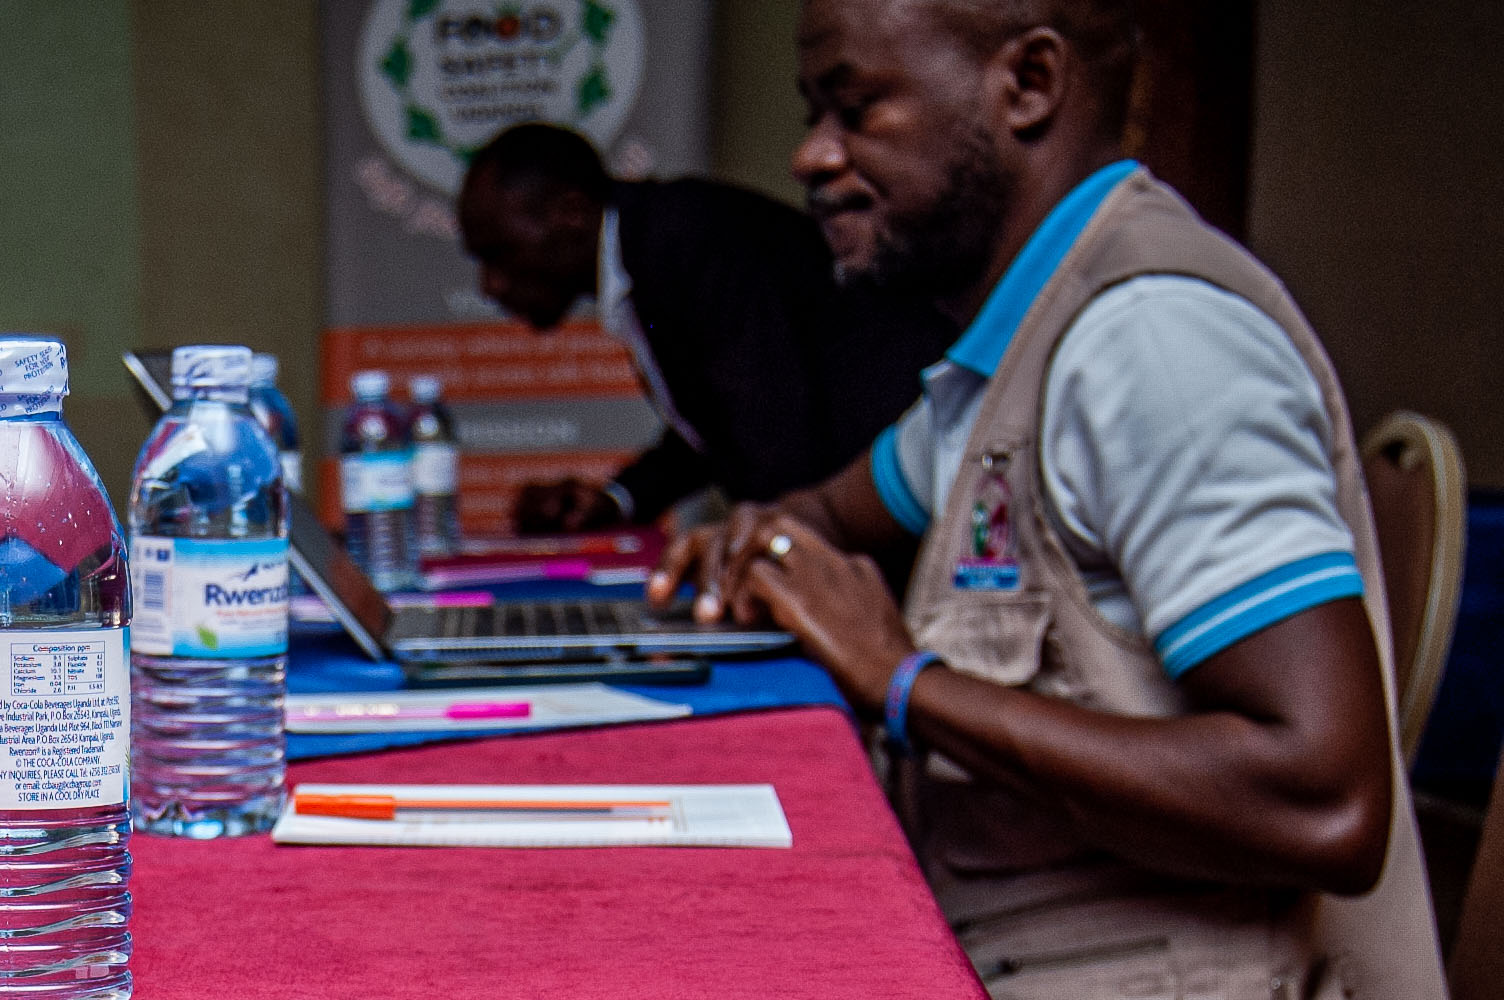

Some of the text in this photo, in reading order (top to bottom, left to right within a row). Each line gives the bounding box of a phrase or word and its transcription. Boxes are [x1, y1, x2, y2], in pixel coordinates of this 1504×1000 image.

[32, 644, 76, 654] Composition
[3, 699, 12, 712] by
[12, 699, 44, 710] Coca-Cola
[44, 699, 73, 712] Beverages
[6, 711, 34, 721] Industrial
[4, 723, 35, 736] Beverages
[35, 722, 58, 736] Uganda
[21, 735, 36, 745] Area
[60, 733, 78, 744] 26543
[41, 746, 47, 756] is
[52, 745, 81, 758] Registered
[23, 758, 36, 768] THE
[36, 757, 74, 768] COCA-COLA
[43, 769, 65, 780] PLEASE
[65, 768, 79, 779] CALL
[18, 792, 40, 802] STORE
[40, 792, 48, 802] IN
[54, 790, 72, 801] COOL
[72, 788, 84, 800] DRY
[84, 788, 100, 800] PLACE
